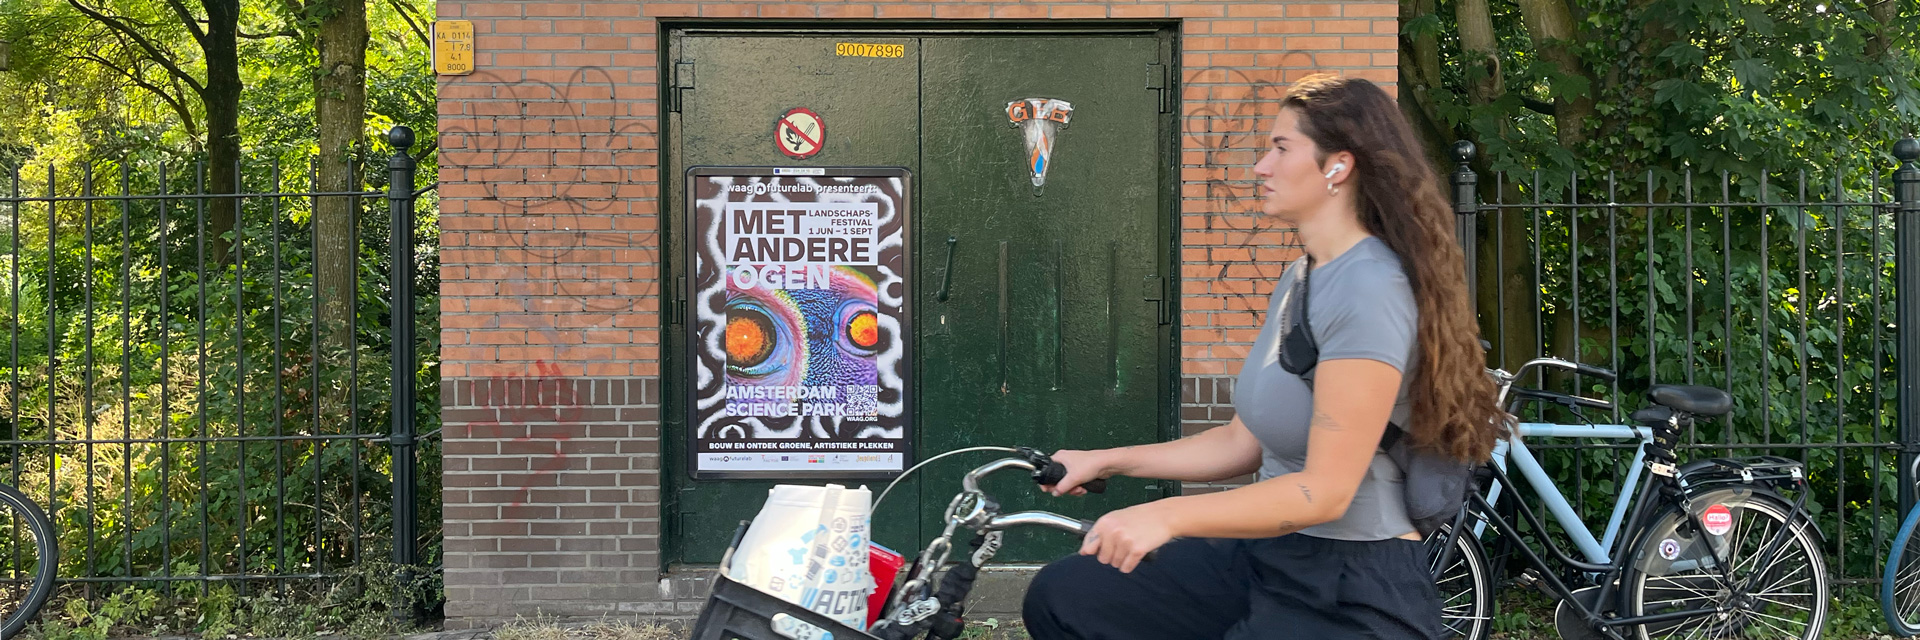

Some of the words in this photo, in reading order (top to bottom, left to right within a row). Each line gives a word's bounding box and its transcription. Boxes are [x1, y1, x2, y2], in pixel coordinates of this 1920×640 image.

[837, 43, 903, 57] 9007896
[727, 185, 753, 194] waag
[766, 183, 813, 193] futurelab
[808, 209, 873, 218] LANDSCHAPS-
[733, 209, 806, 235] MET
[831, 218, 873, 226] FESTIVAL
[815, 227, 834, 235] JUN
[849, 227, 873, 235] SEPT
[732, 237, 870, 262] ANDERE
[732, 264, 830, 290] OGEN
[726, 385, 836, 400] AMSTERDAM
[726, 402, 799, 417] SCIENCE
[802, 402, 847, 417] PARK
[779, 442, 812, 451] GROENE,
